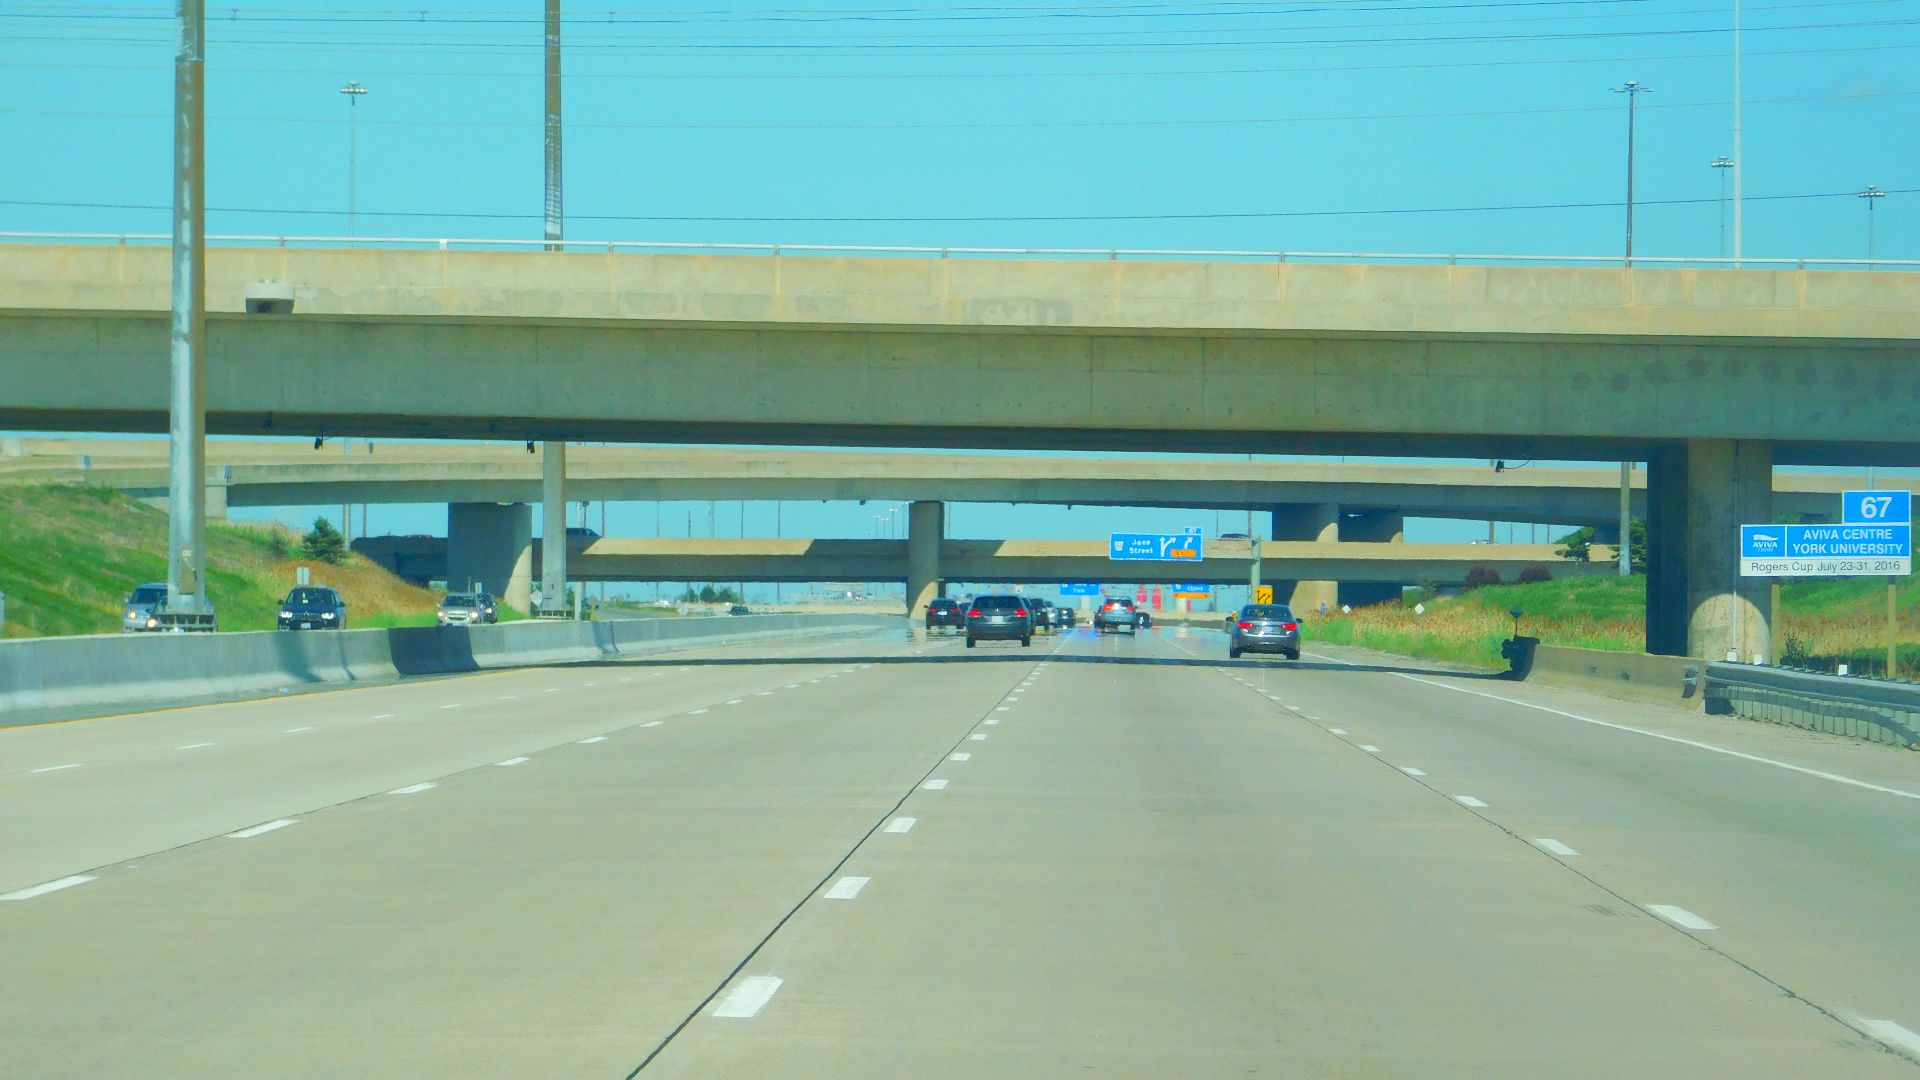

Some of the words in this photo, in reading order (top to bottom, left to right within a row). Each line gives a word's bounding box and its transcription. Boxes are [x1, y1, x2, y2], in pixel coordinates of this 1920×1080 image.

[1860, 496, 1893, 518] 67
[1803, 529, 1838, 540] AVIVA
[1842, 529, 1892, 540] CENTRE
[1793, 544, 1827, 554] YORK
[1831, 543, 1903, 554] UNIVERSITY
[1751, 563, 1789, 573] Rogers
[1792, 562, 1813, 572] Cup
[1817, 562, 1837, 572] July
[1875, 561, 1901, 571] 2016
